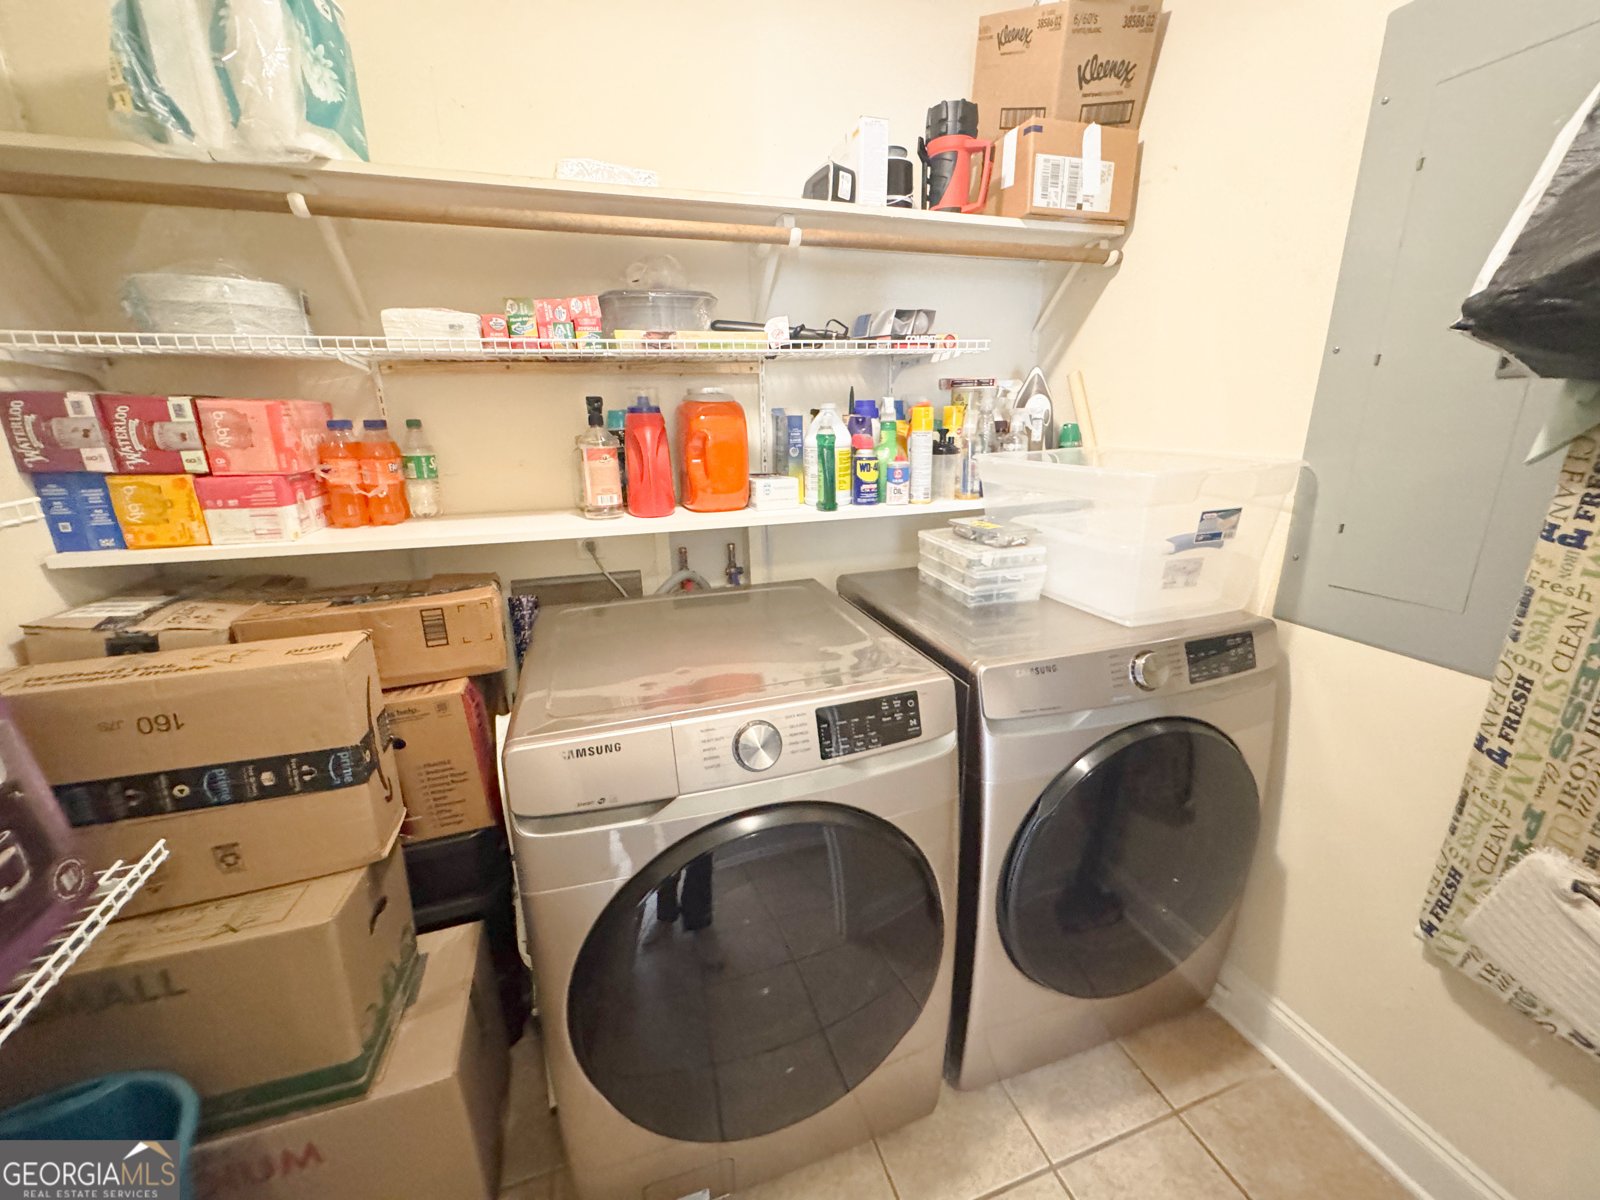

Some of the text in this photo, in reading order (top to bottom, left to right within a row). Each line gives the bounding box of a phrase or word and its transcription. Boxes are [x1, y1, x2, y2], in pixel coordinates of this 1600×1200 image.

[996, 25, 1033, 50] Kleenex
[1077, 54, 1137, 90] Kleenex
[9, 400, 49, 468] WATERLOO
[113, 405, 150, 470] WATERLOO
[213, 410, 232, 448] bubly
[123, 485, 145, 524] bubly
[1526, 569, 1593, 603] Fresh
[1552, 605, 1592, 673] CLEAN
[136, 713, 185, 735] 160
[1498, 673, 1535, 745] FRESH
[1503, 671, 1569, 802] STEAM
[338, 750, 354, 785] prime
[1556, 740, 1598, 810] IRON
[1476, 817, 1511, 875] CLEAN
[1429, 865, 1464, 924] FRESH
